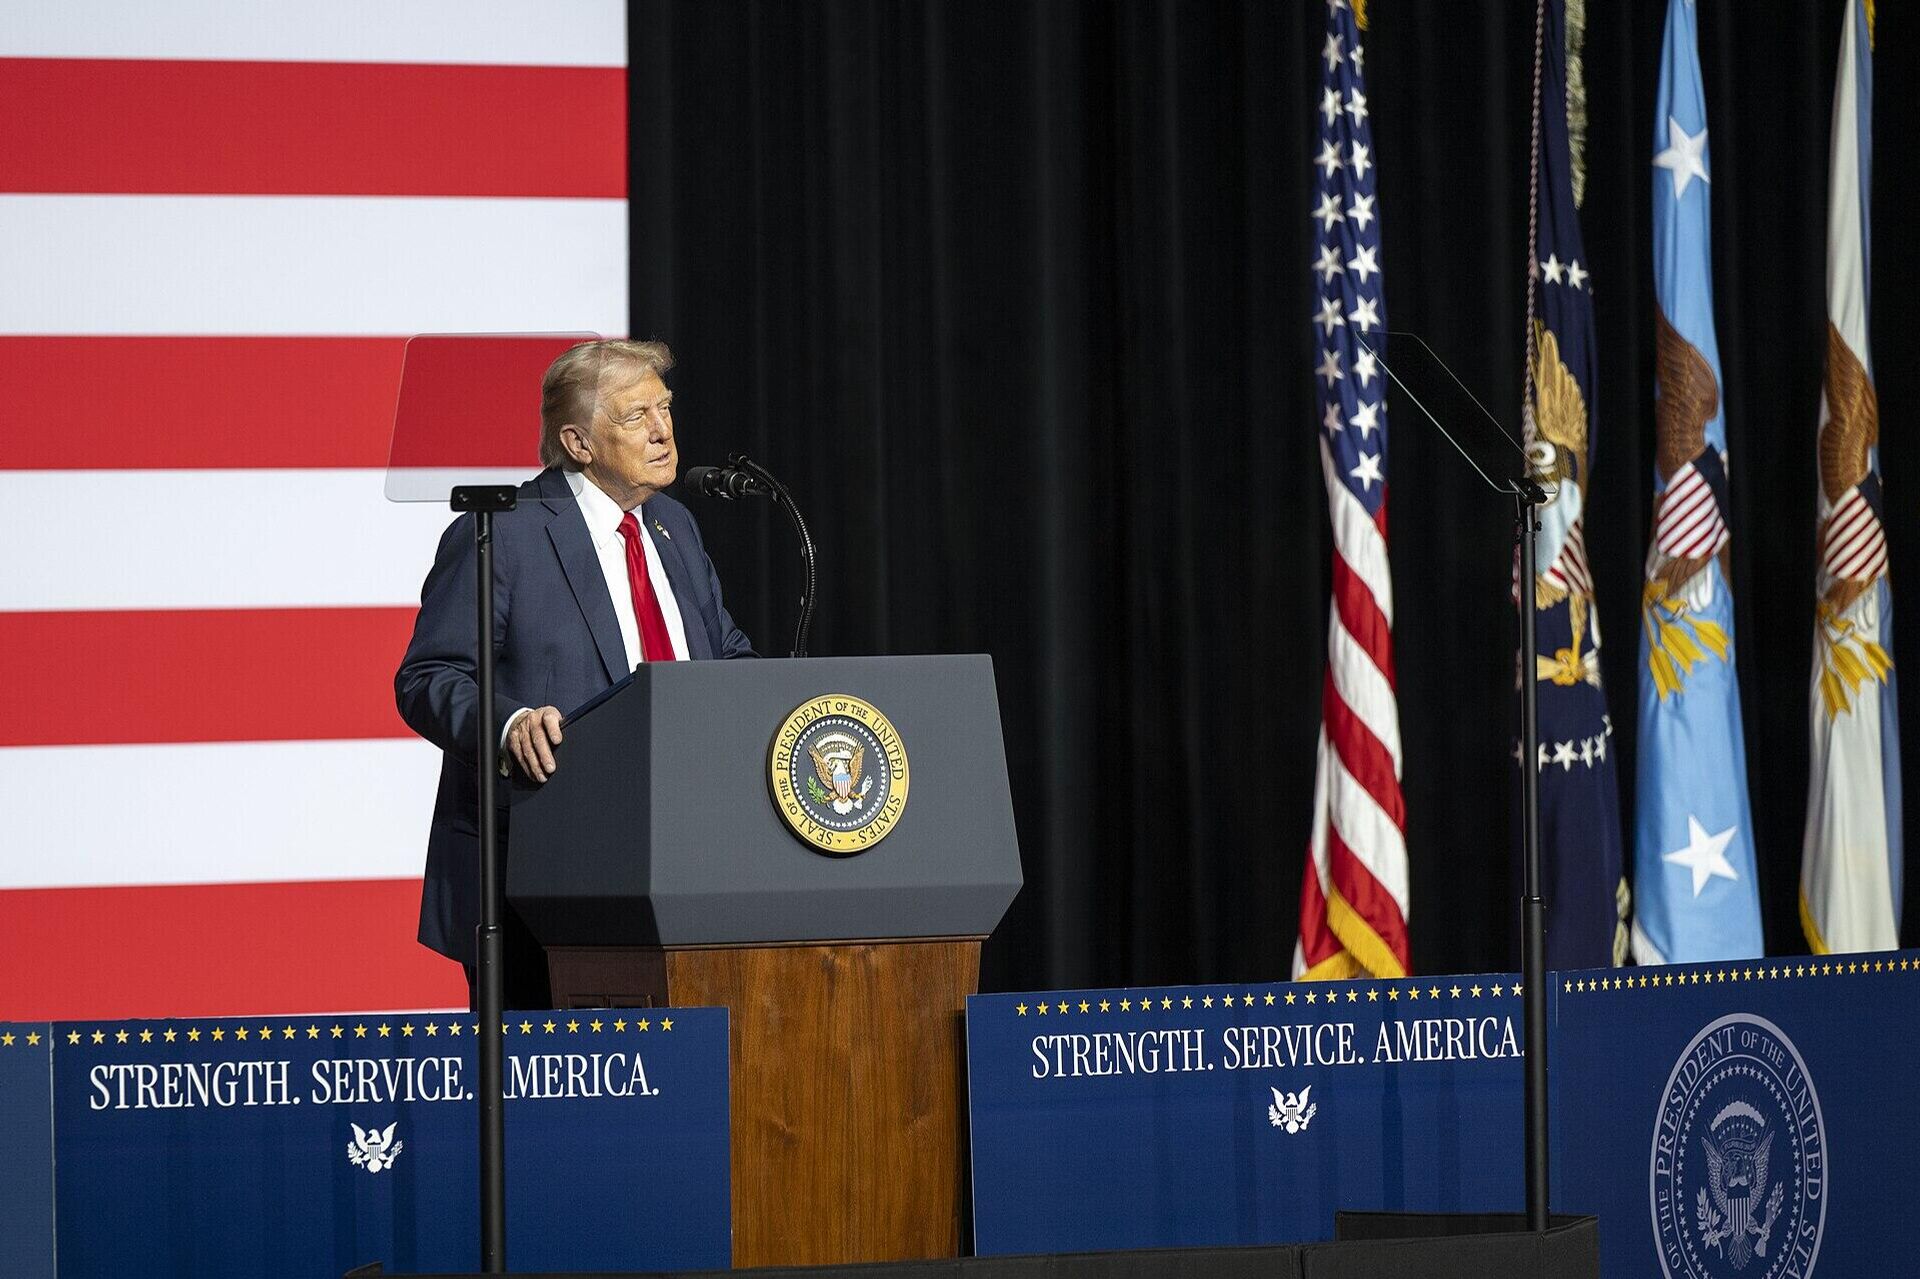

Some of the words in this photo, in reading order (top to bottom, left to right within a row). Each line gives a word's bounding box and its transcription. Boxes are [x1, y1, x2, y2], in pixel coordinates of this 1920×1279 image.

[835, 701, 850, 712] OF
[850, 704, 870, 720] THE
[776, 700, 832, 772] PRESIDENT
[871, 716, 905, 780] UNITED
[779, 778, 792, 800] THE
[786, 801, 798, 816] OF
[800, 814, 834, 846] SEAL
[858, 793, 902, 845] STATES
[1031, 1028, 1214, 1078] STRENGTH.
[1223, 1022, 1365, 1069] SERVICE.
[1740, 1029, 1760, 1050] OF
[1761, 1036, 1787, 1069] THE
[90, 1059, 301, 1110] STRENGTH.
[311, 1056, 474, 1105] SERVICE.
[502, 1052, 660, 1099] MERICA.
[1656, 1025, 1736, 1179] PRESIDENT
[1784, 1063, 1822, 1201] UNITED
[1658, 1188, 1673, 1237] THE
[1665, 1241, 1682, 1270] OF
